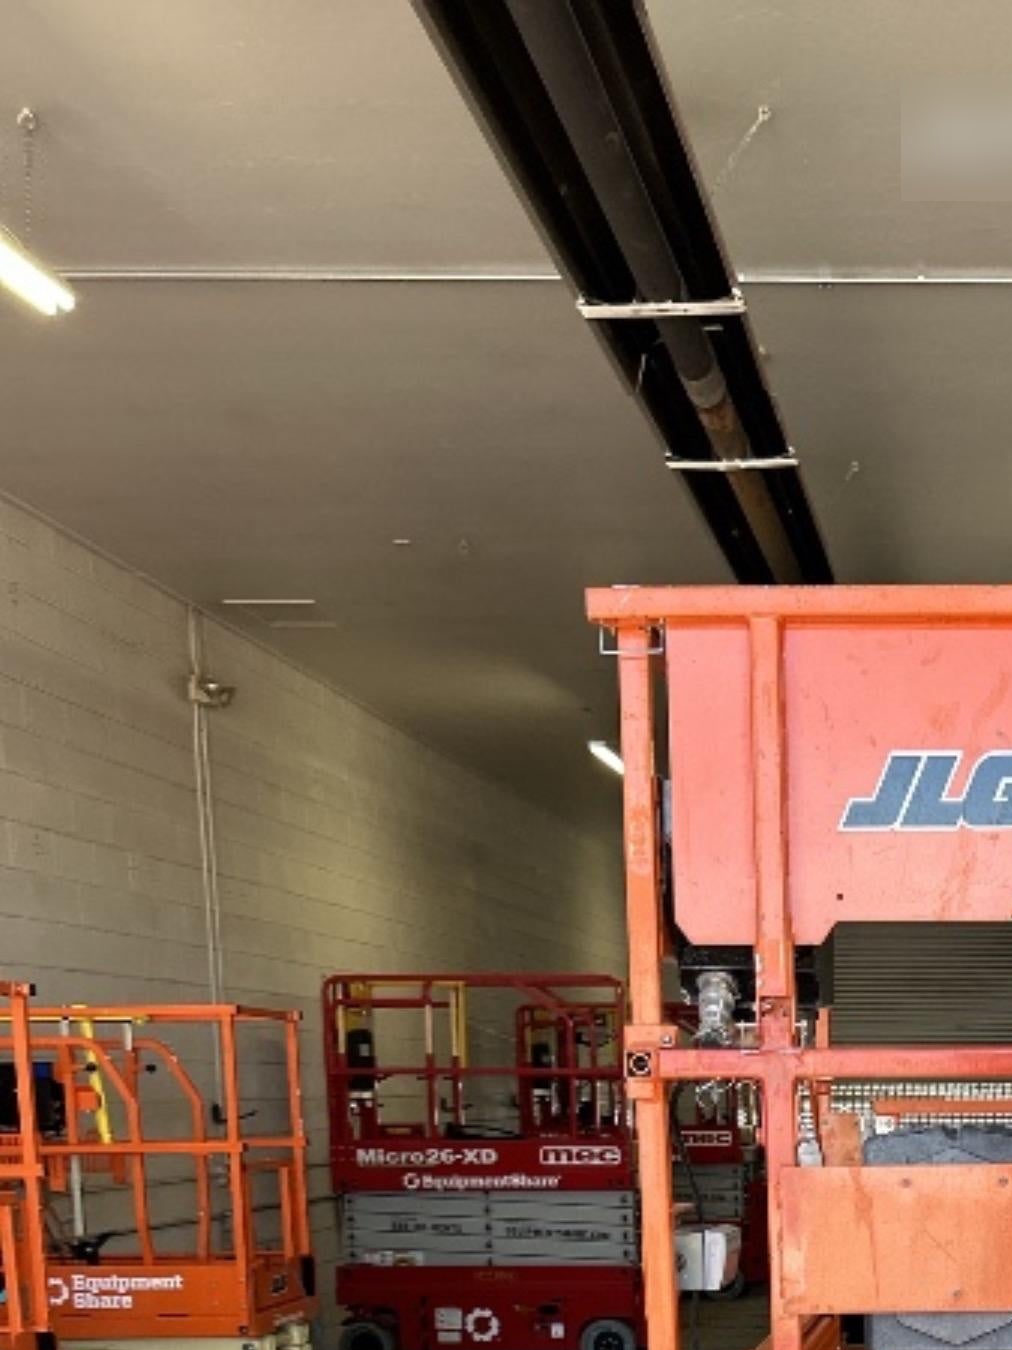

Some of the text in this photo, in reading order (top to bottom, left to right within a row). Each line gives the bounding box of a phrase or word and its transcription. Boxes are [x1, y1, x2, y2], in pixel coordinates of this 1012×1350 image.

[356, 1149, 498, 1166] Micro26-XD
[422, 1174, 561, 1190] EquipmentShare
[71, 1274, 183, 1293] Equipment
[72, 1292, 133, 1308] Share
